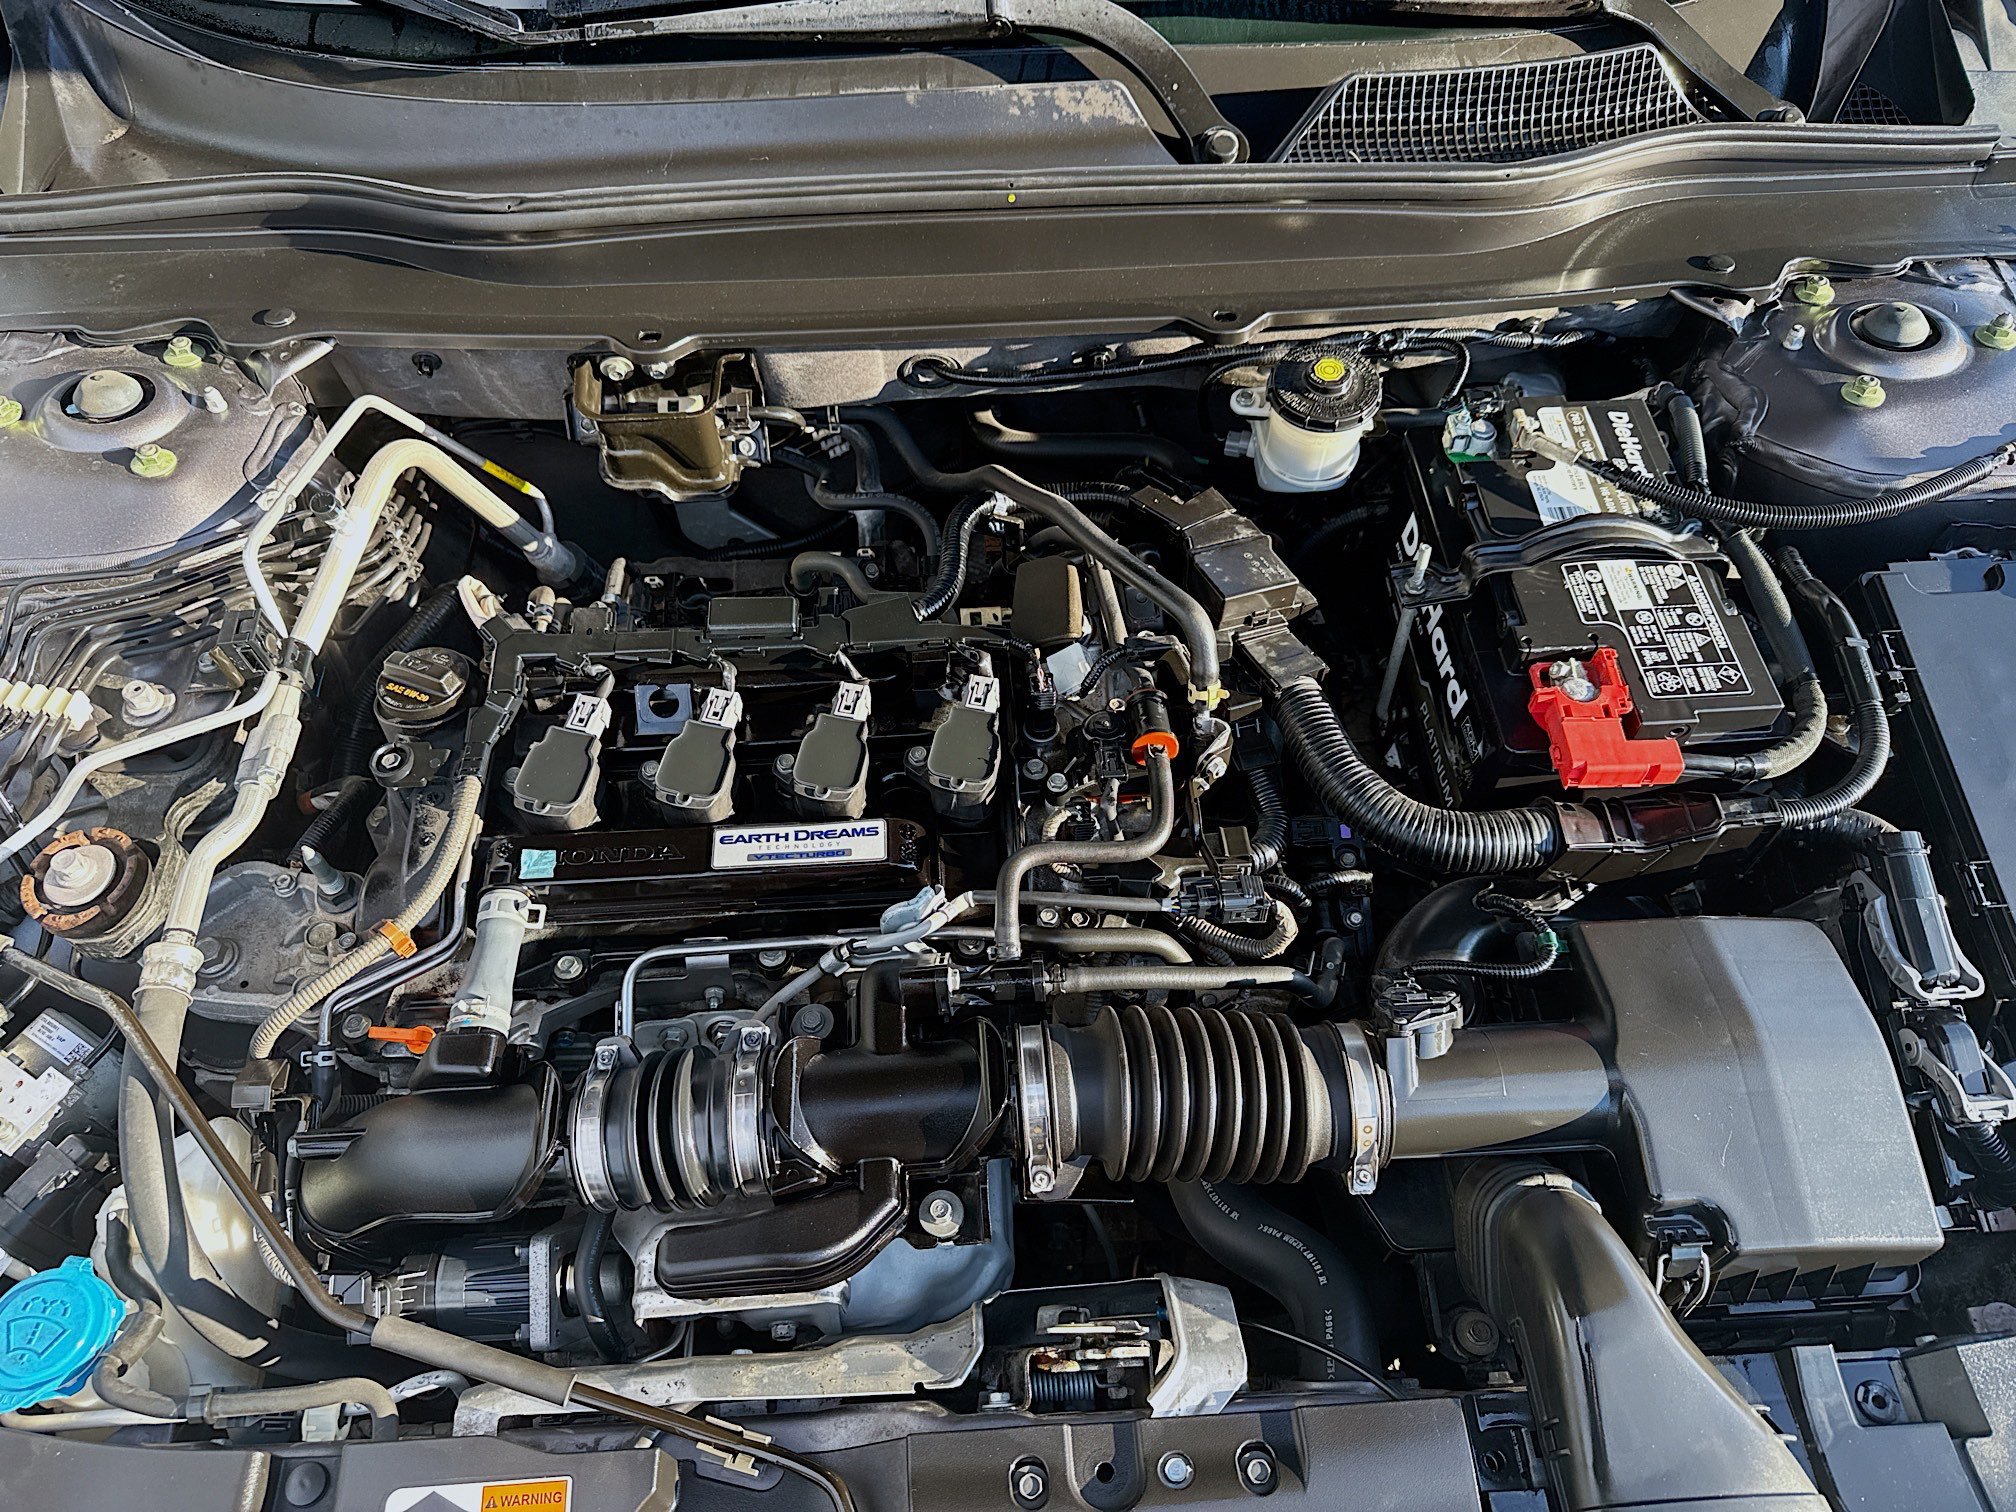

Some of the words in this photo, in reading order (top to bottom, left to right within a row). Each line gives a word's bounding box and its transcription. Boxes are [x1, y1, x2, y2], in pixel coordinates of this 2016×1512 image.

[1401, 511, 1469, 720] DHard
[1691, 581, 1729, 649] DANGER/POISON
[386, 683, 405, 694] SAE
[404, 688, 430, 702] 0W-20
[1420, 701, 1454, 808] PLATINUM
[719, 832, 790, 844] EARTH
[794, 826, 879, 841] DREAMS
[556, 844, 685, 866] ONDA
[758, 841, 841, 851] TECHNOLOGY
[500, 1491, 563, 1508] WARNING
